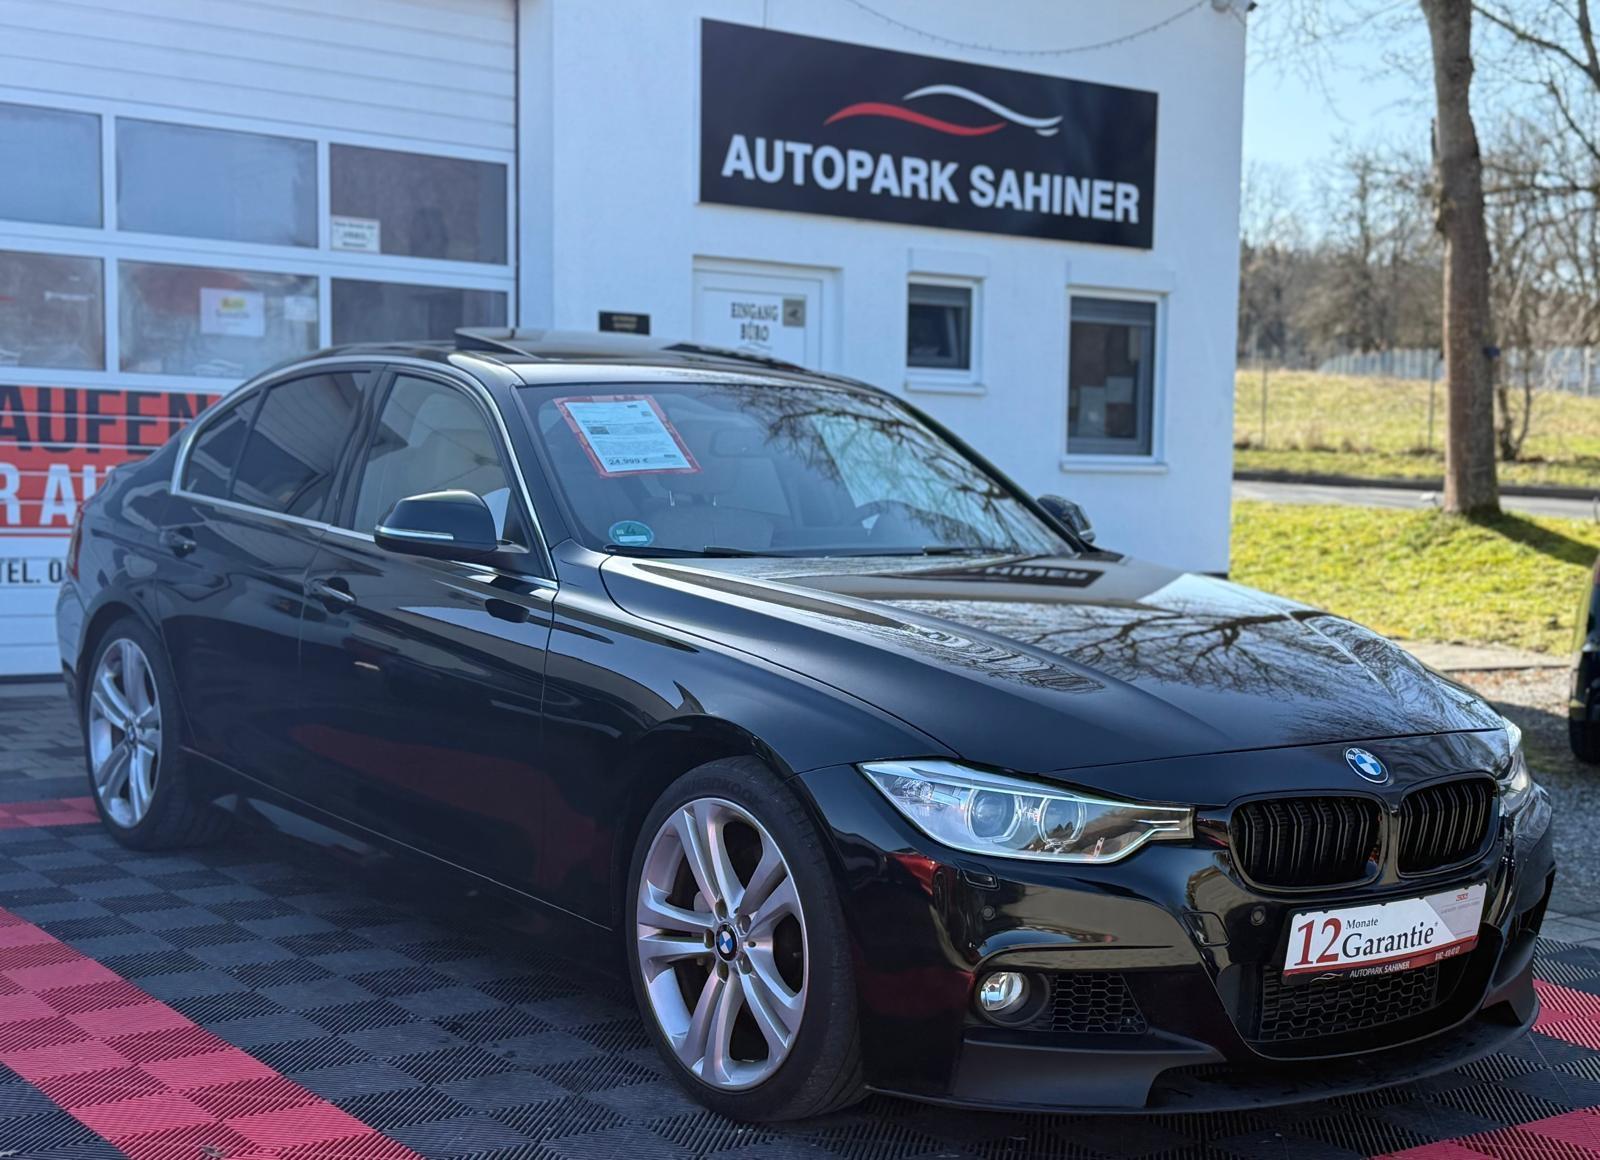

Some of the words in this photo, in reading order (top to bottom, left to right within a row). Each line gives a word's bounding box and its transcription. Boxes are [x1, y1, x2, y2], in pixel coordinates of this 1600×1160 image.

[721, 134, 959, 203] AUTOPARK
[969, 164, 1139, 224] SAHINER
[731, 302, 778, 322] EINGANG
[1294, 917, 1342, 966] 12
[1345, 917, 1379, 930] Monate
[1349, 966, 1383, 978] AUTOPARK
[1384, 961, 1411, 974] SAHINER
